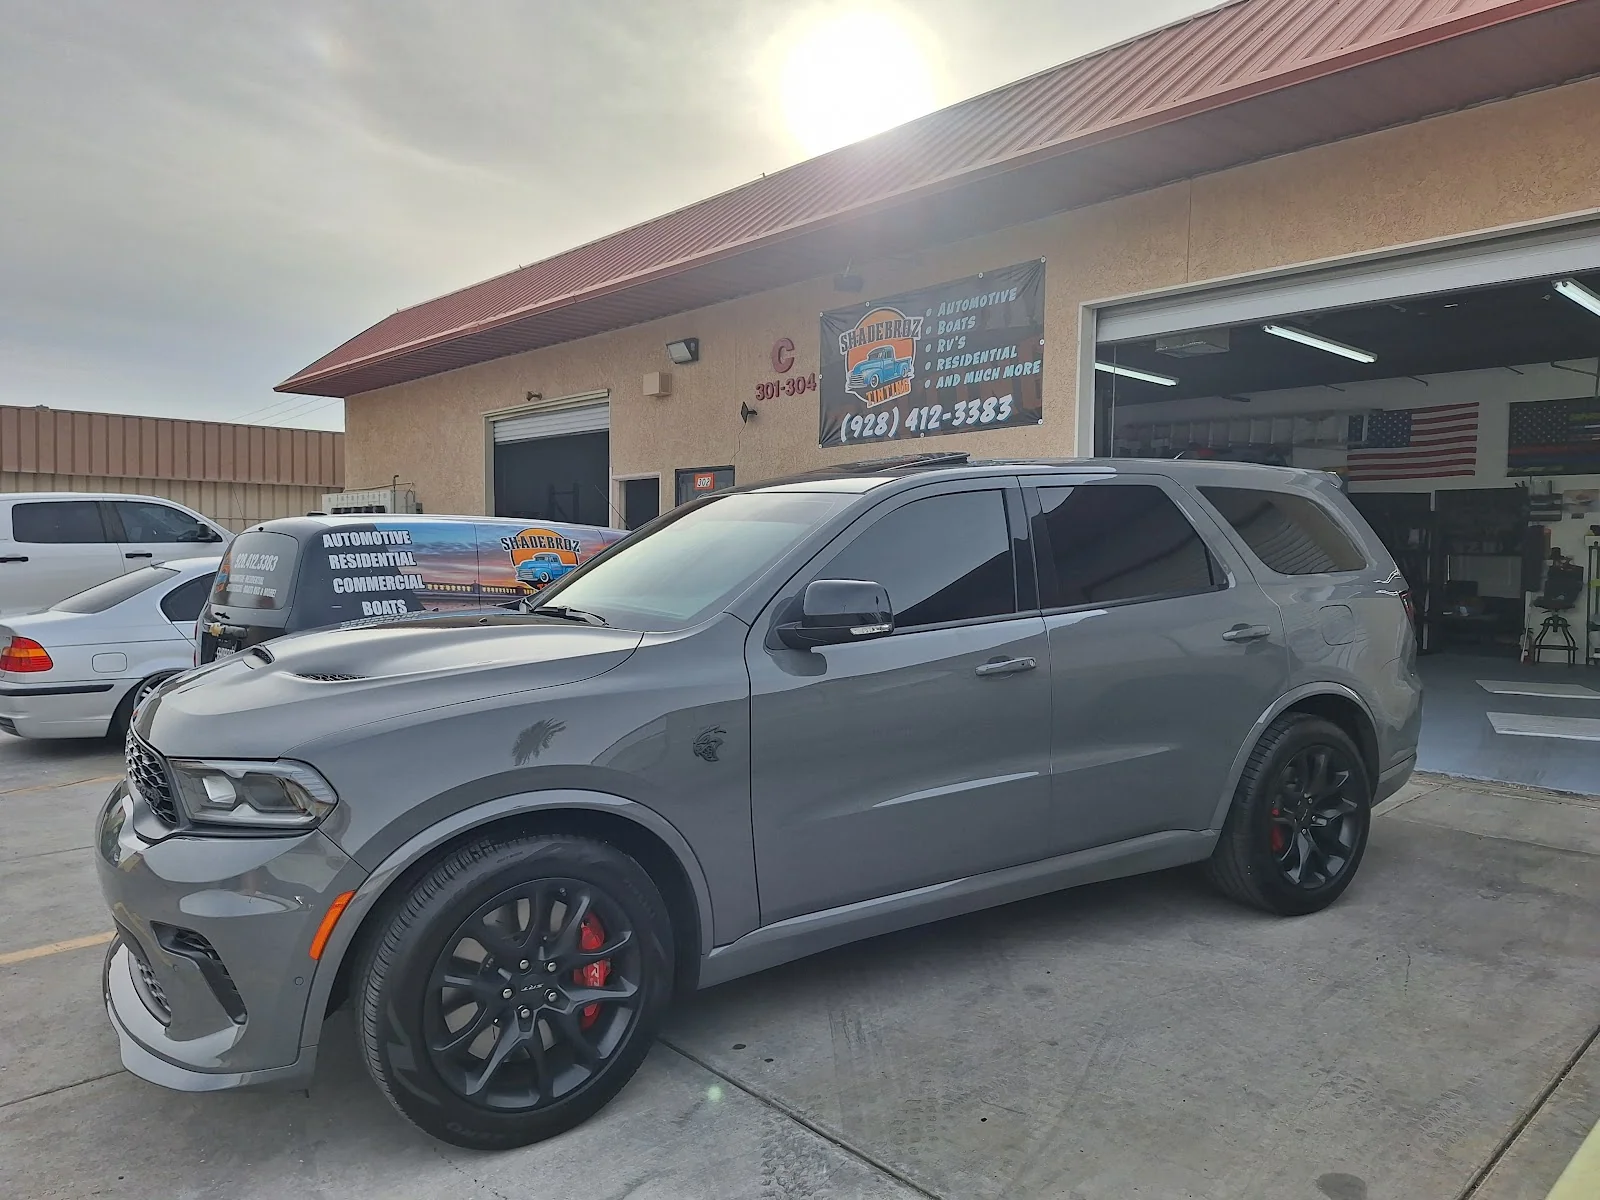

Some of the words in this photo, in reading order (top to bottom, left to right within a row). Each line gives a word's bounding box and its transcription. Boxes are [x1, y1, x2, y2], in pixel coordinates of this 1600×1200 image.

[937, 287, 1018, 317] AUTOMOTIVE
[840, 318, 922, 353] SHADEBROZ
[937, 315, 976, 335] BOATS
[771, 338, 795, 373] C
[936, 335, 966, 353] RV'S
[936, 345, 1018, 371] RESIDENTIAL
[755, 372, 817, 401] 301-304
[936, 373, 961, 389] AND
[963, 367, 1001, 385] MUCH
[1002, 360, 1042, 379] MORE
[865, 378, 911, 406] TINTING
[840, 406, 900, 442] (928)
[905, 394, 1013, 432] 412-3383
[322, 530, 413, 549] AUTOMOTIVE
[500, 535, 581, 552] SHADEBROZ
[328, 551, 418, 570] RESIDENTIAL
[332, 574, 426, 594] COMMERCIAL
[361, 599, 408, 616] BOATS
